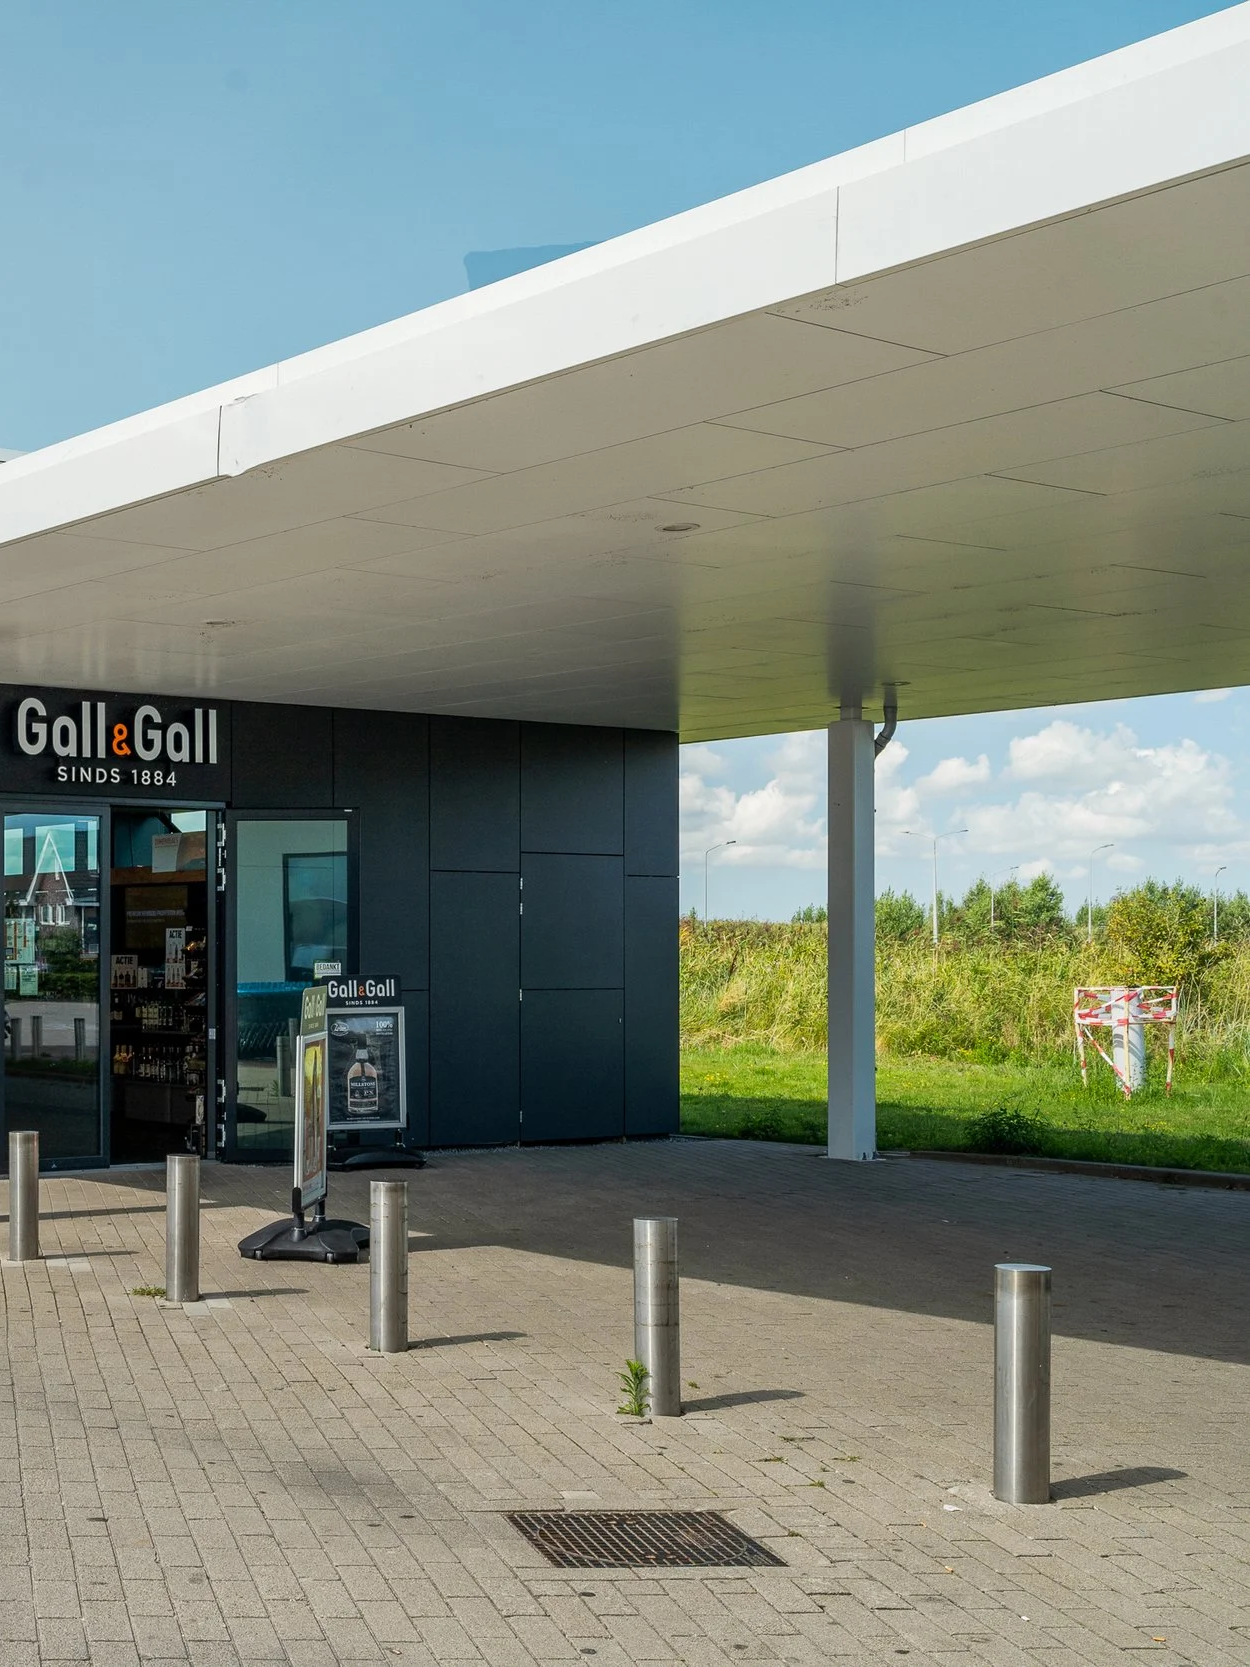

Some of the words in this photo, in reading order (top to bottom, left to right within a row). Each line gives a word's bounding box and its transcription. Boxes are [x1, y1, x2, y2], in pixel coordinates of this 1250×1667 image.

[17, 697, 218, 764] Gall&Gall
[57, 766, 120, 784] SINDS
[131, 769, 177, 787] 1884
[169, 930, 182, 939] ACTIE
[116, 956, 133, 964] ACTIE
[328, 979, 395, 998] Gall&Gall
[375, 1021, 393, 1029] 100%
